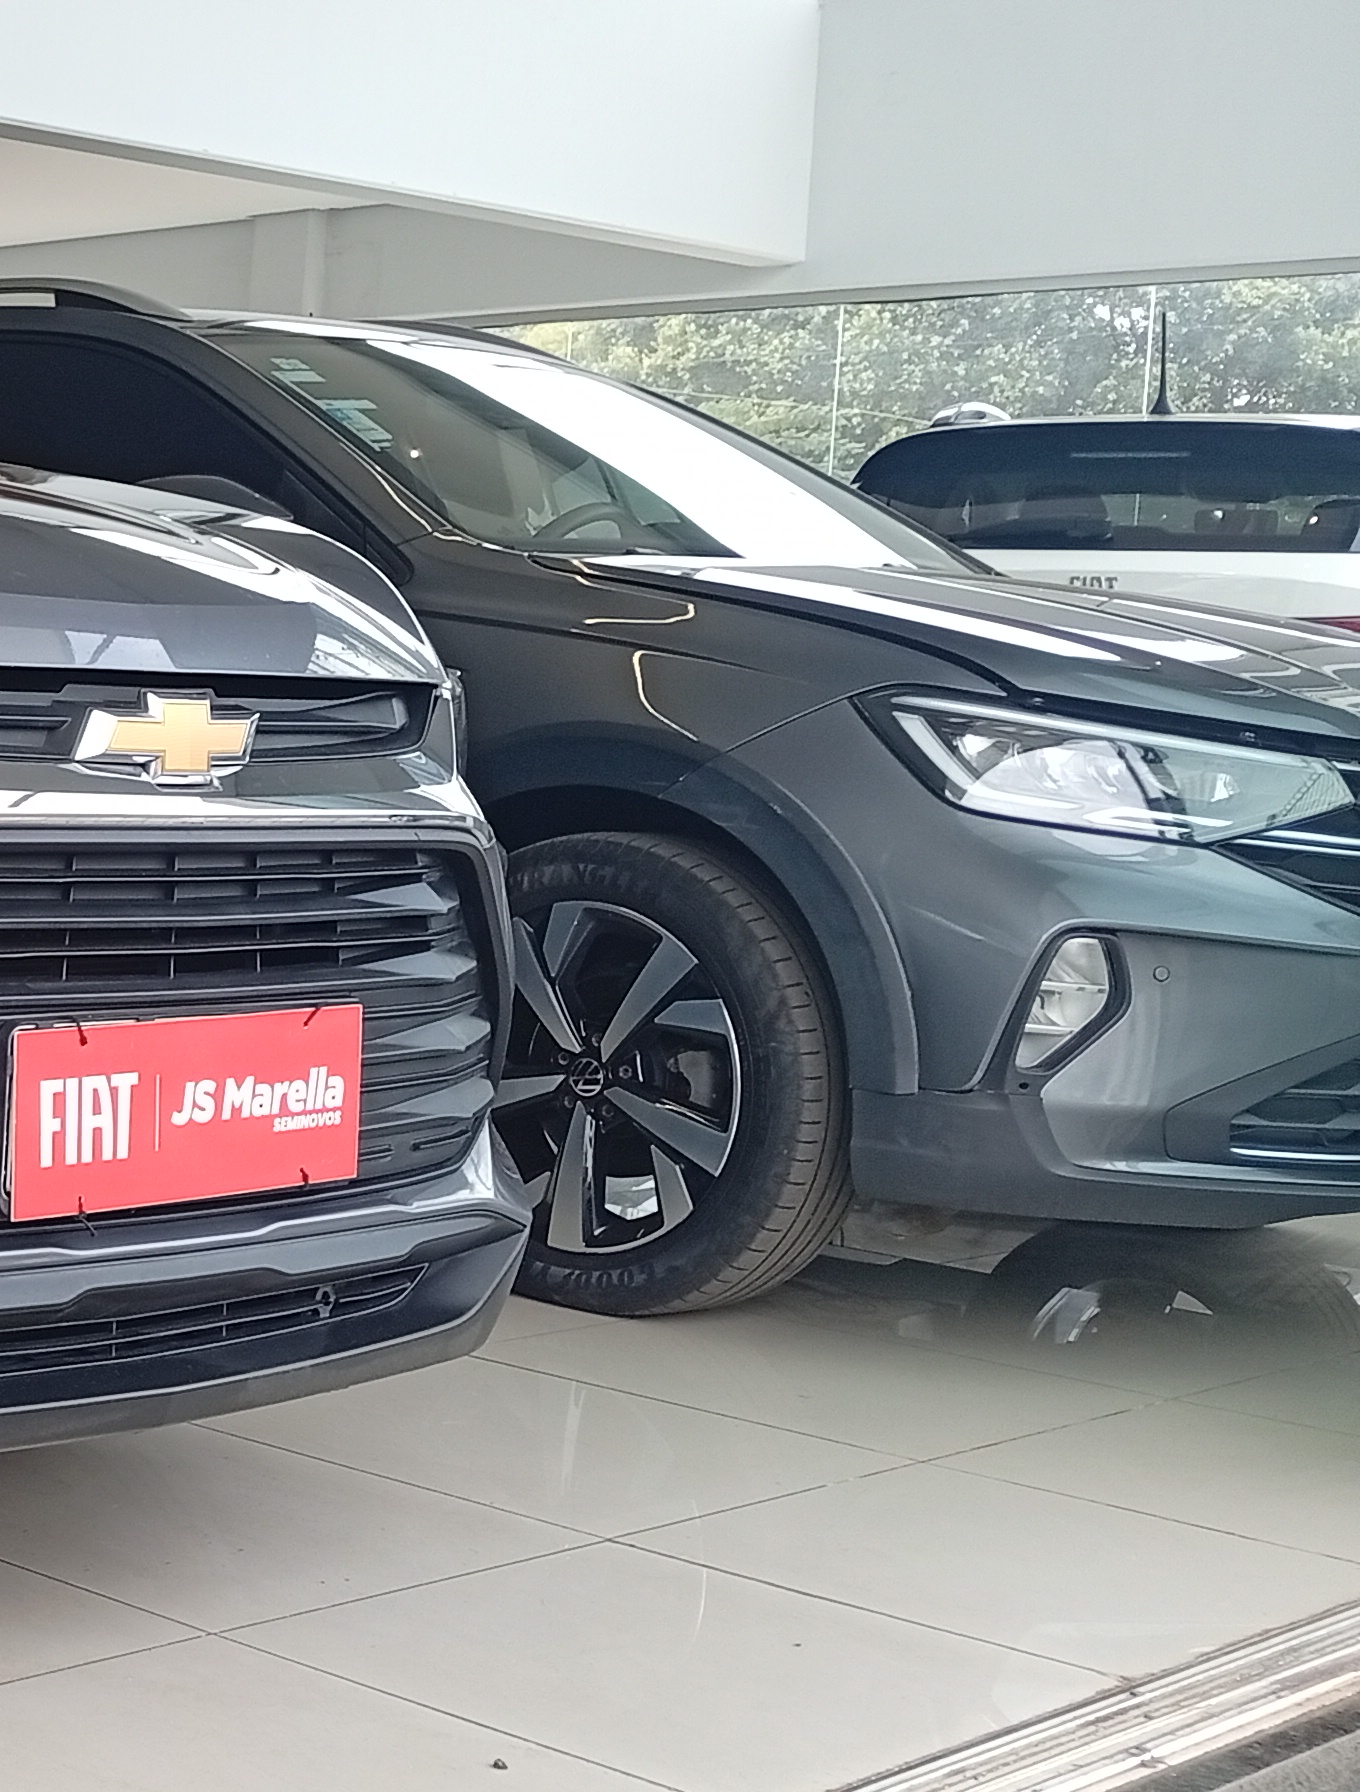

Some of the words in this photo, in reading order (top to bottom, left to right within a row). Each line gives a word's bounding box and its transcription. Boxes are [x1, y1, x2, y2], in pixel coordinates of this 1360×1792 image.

[39, 1071, 140, 1169] FIAT
[170, 1078, 217, 1127] JS
[221, 1065, 346, 1121] Marella
[272, 1110, 343, 1133] SEMINOVOS
